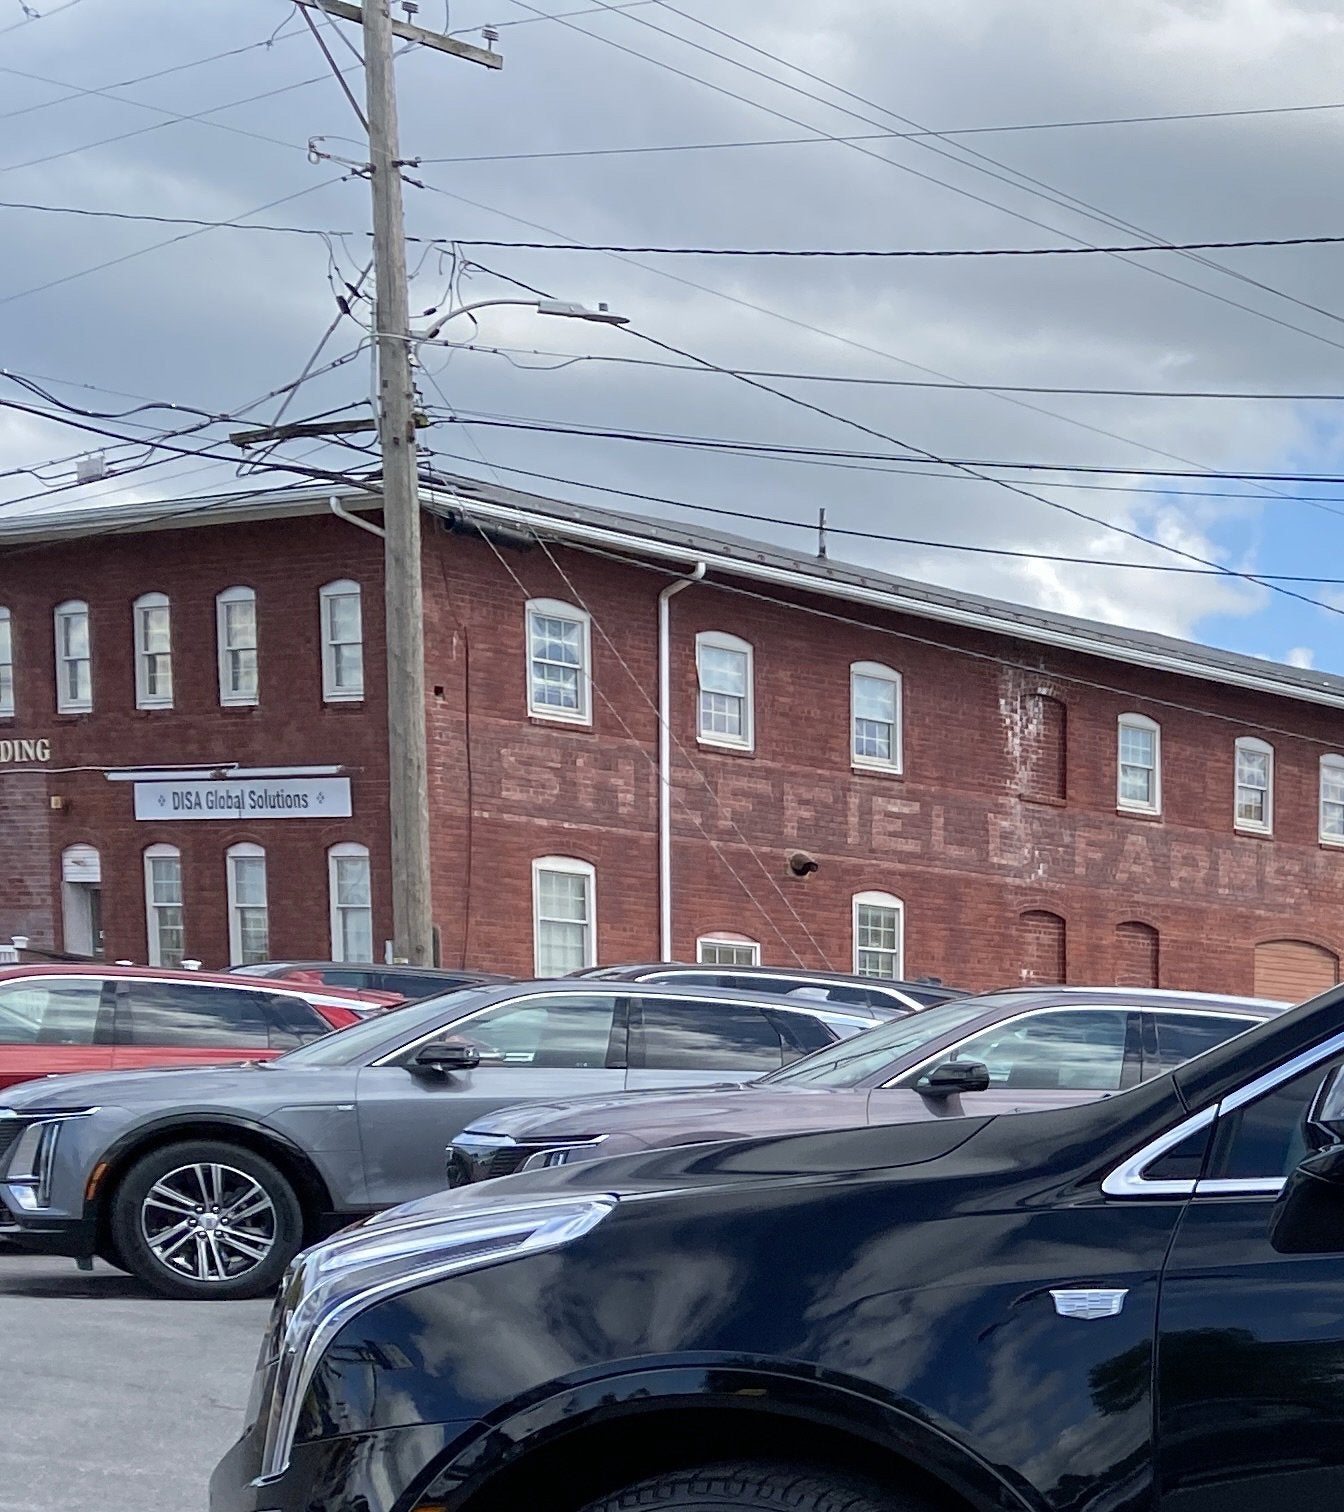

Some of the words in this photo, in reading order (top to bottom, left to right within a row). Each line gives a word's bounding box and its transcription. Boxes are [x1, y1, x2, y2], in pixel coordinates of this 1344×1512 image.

[0, 739, 50, 762] DING
[172, 790, 202, 810] DISA
[206, 788, 245, 810] Global
[249, 788, 309, 810] Solutions
